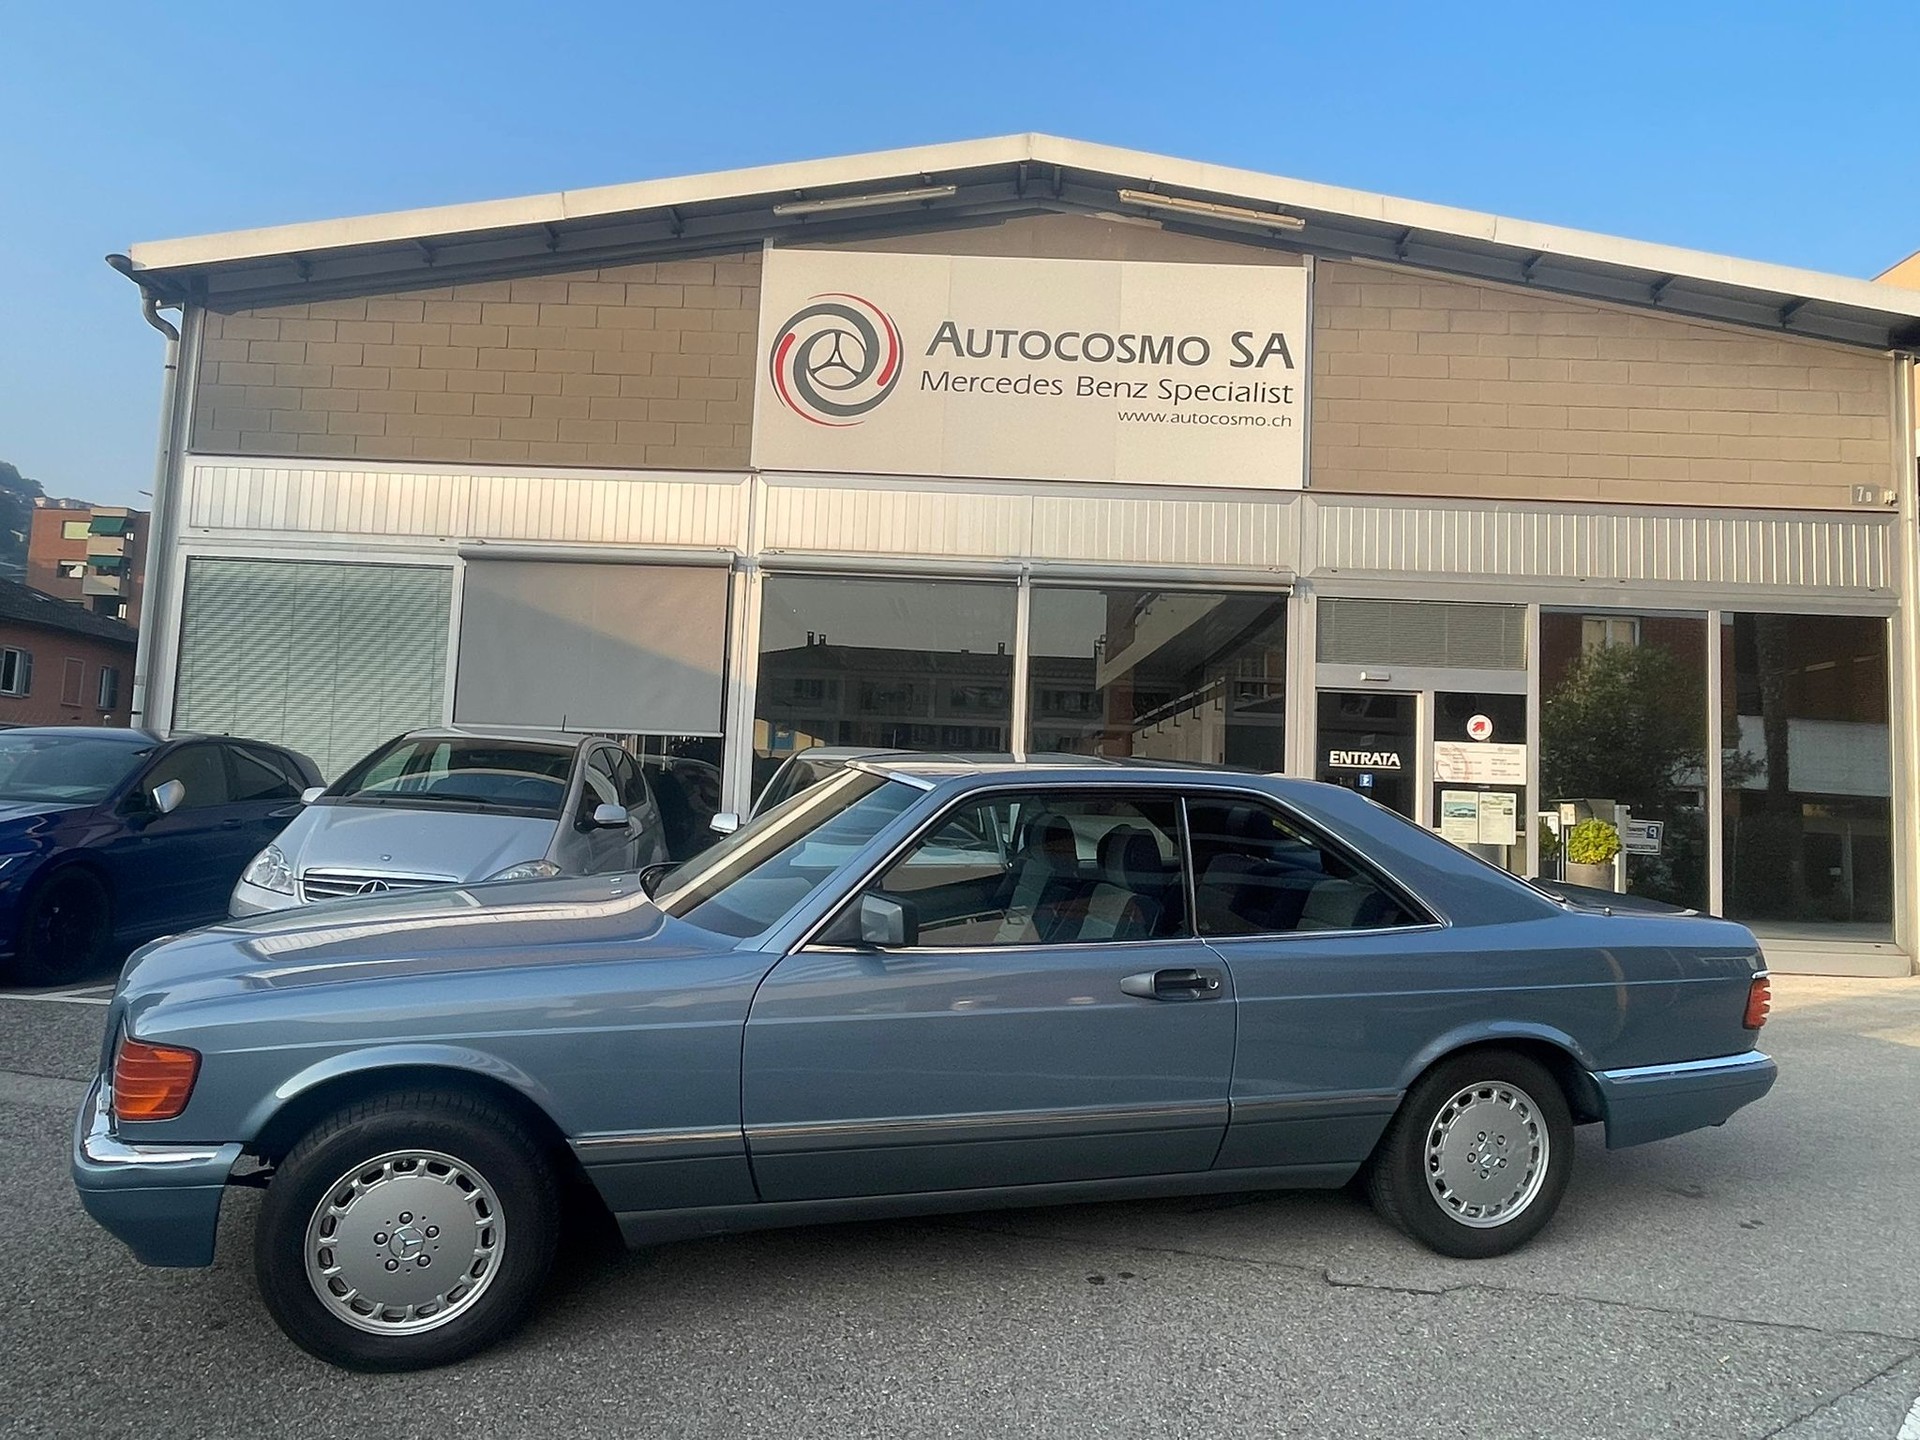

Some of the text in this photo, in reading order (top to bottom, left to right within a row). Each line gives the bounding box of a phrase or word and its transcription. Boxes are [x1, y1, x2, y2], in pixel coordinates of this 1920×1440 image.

[925, 321, 1295, 369] AUTOCOSMO SA
[920, 370, 1294, 405] Mercedes Benz Specialist
[1117, 411, 1292, 427] www.autocosmo.ch
[1329, 750, 1401, 767] ENTRATA
